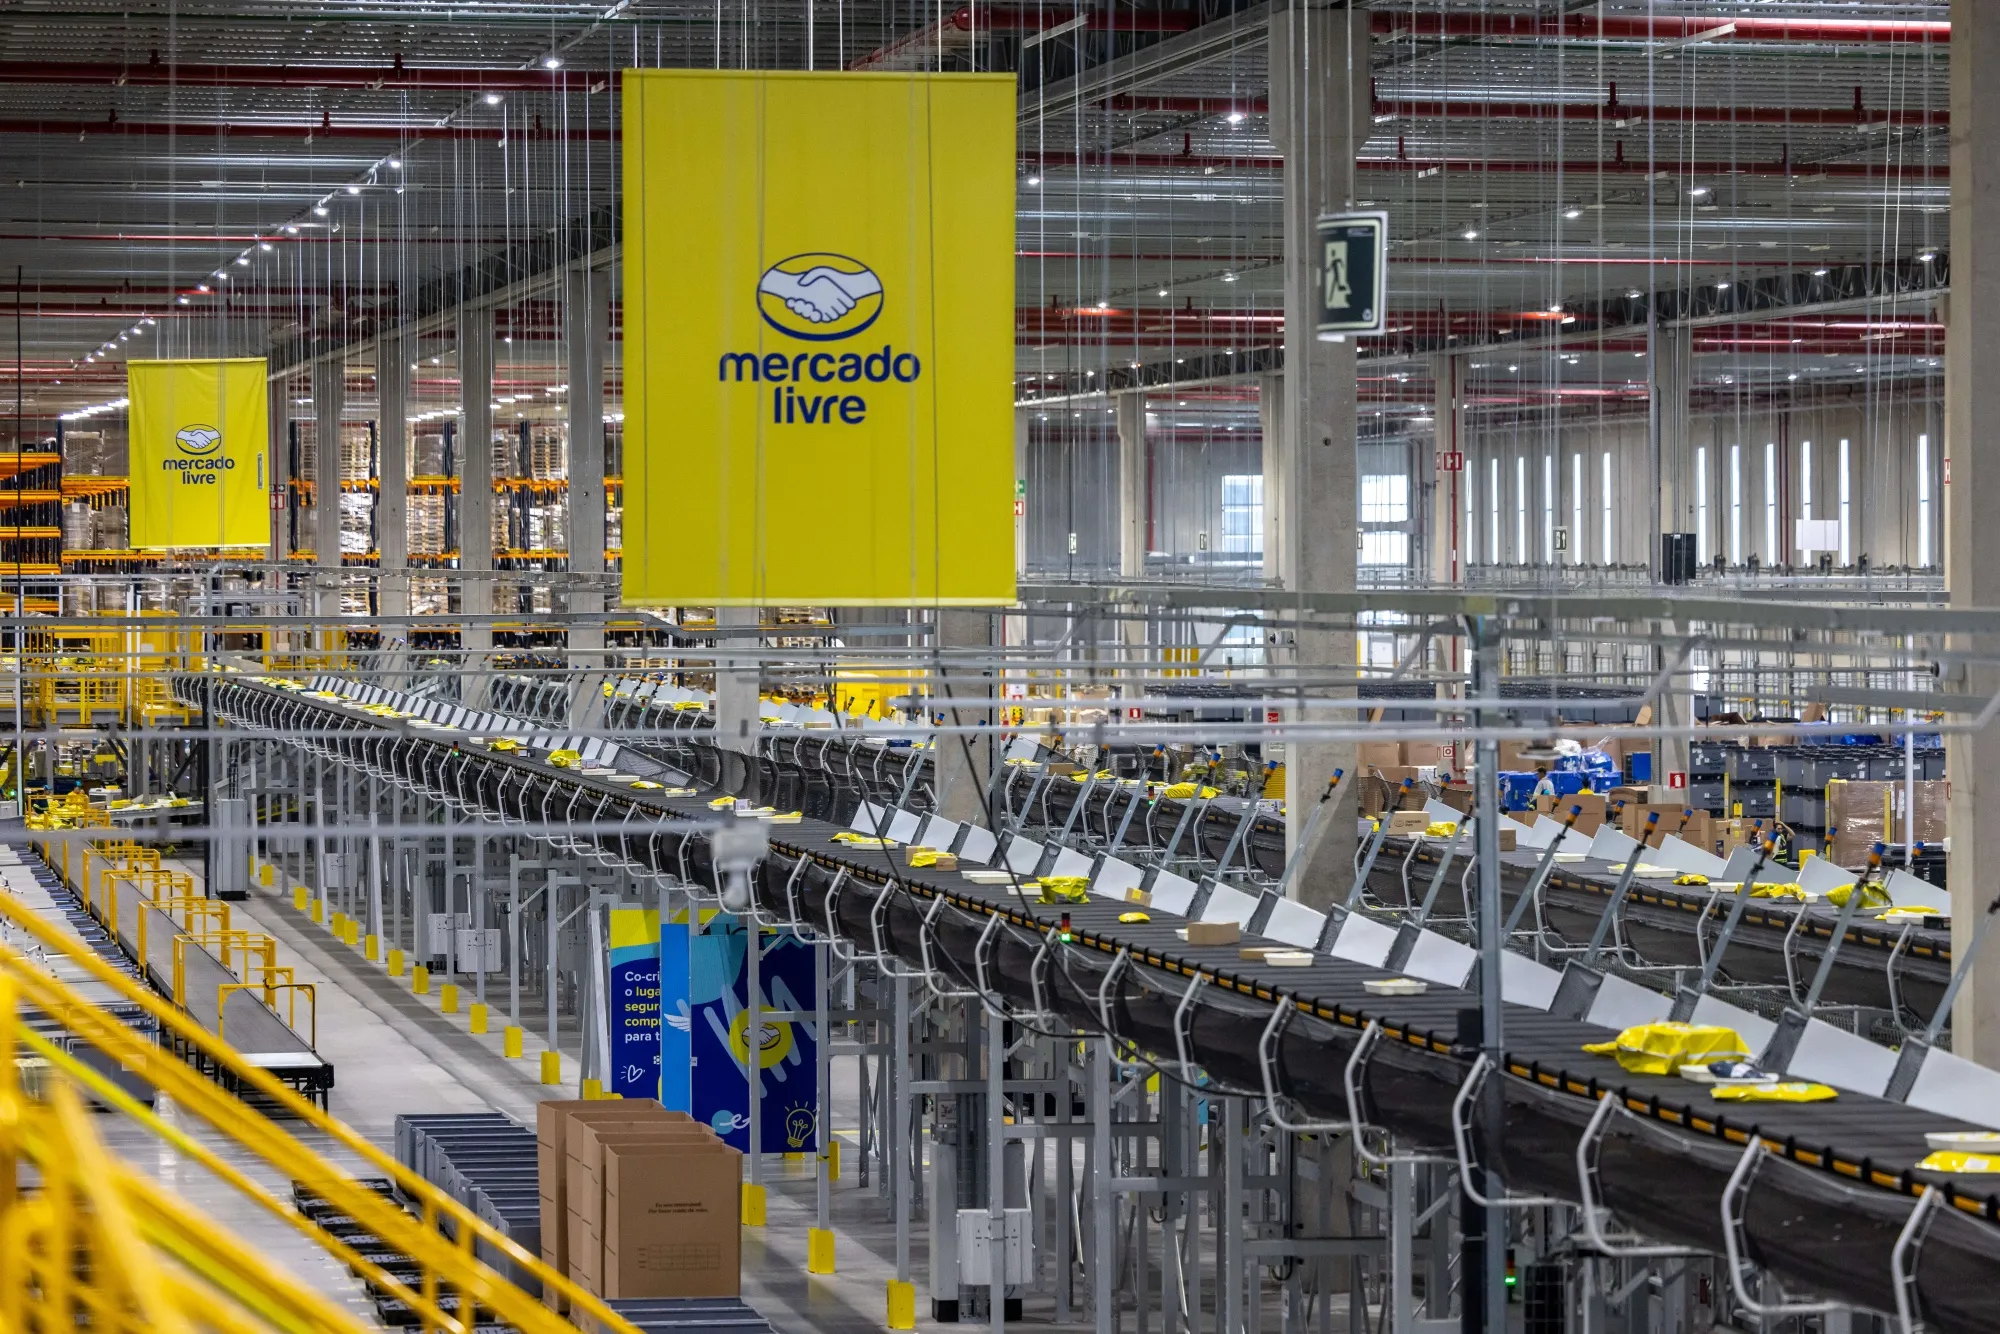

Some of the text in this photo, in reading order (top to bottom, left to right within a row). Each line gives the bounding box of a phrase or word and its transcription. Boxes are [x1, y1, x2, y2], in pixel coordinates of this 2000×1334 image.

[719, 344, 921, 383] mercado
[774, 386, 867, 424] livre
[163, 456, 235, 470] mercado
[182, 471, 216, 485] livre
[625, 988, 633, 996] o
[625, 1002, 660, 1013] segur
[625, 1033, 652, 1043] para
